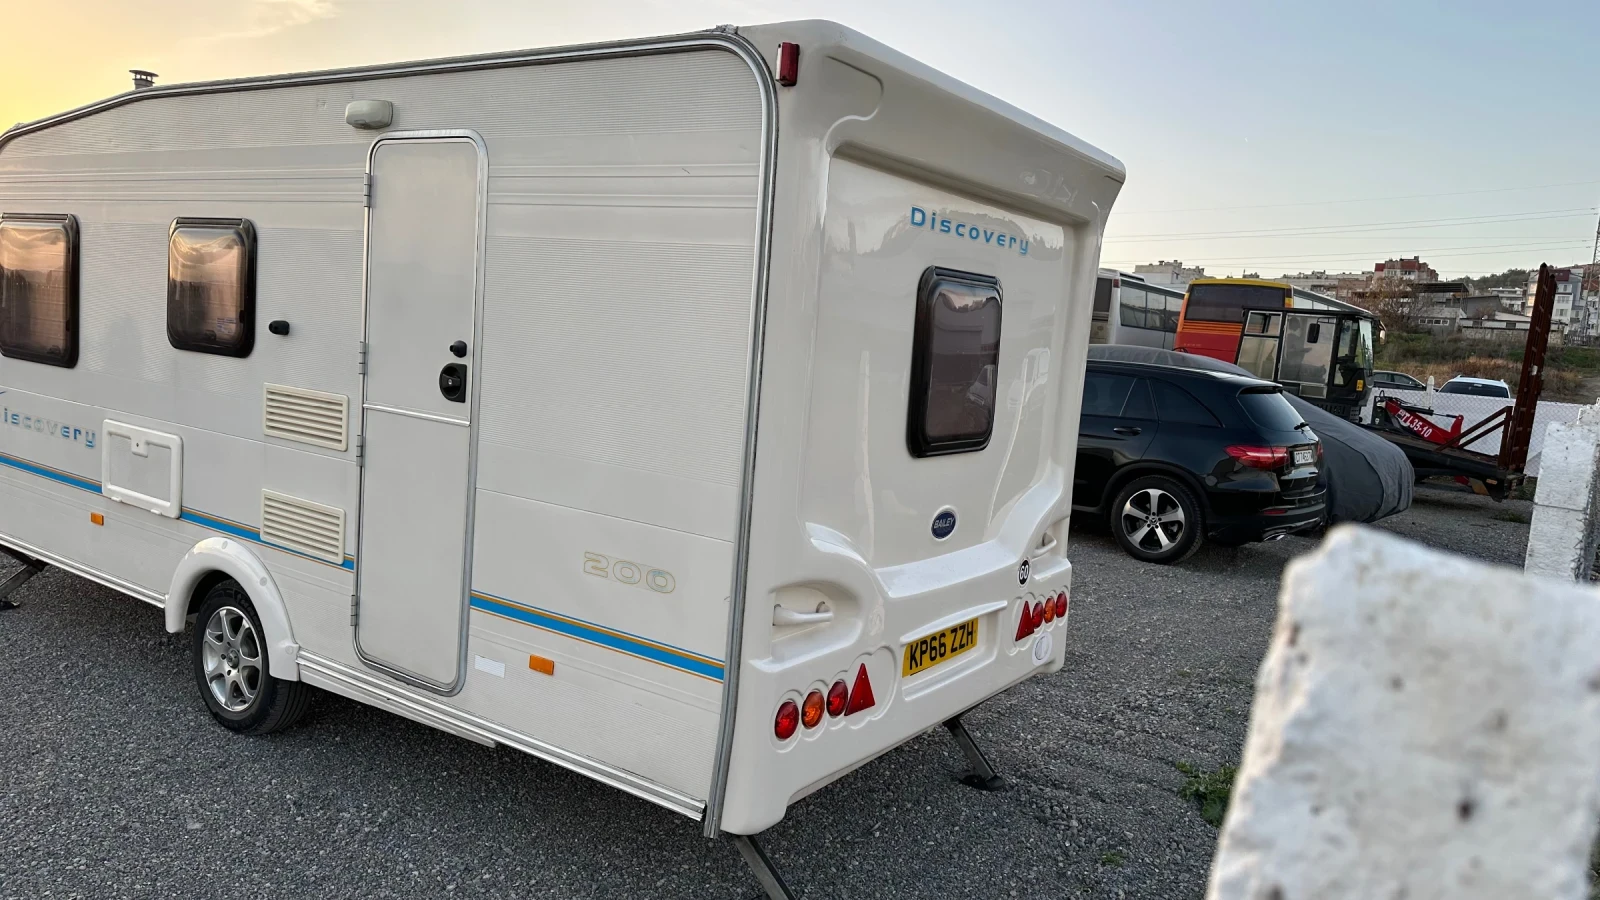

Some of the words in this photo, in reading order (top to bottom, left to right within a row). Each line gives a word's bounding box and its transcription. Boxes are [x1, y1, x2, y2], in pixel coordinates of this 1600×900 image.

[910, 206, 1029, 256] Discovery
[1, 407, 96, 449] iscovery
[933, 517, 955, 529] BAILEY
[583, 551, 676, 594] 200
[1020, 565, 1029, 580] 60
[909, 632, 947, 670] KP66
[950, 620, 974, 653] ZZH
